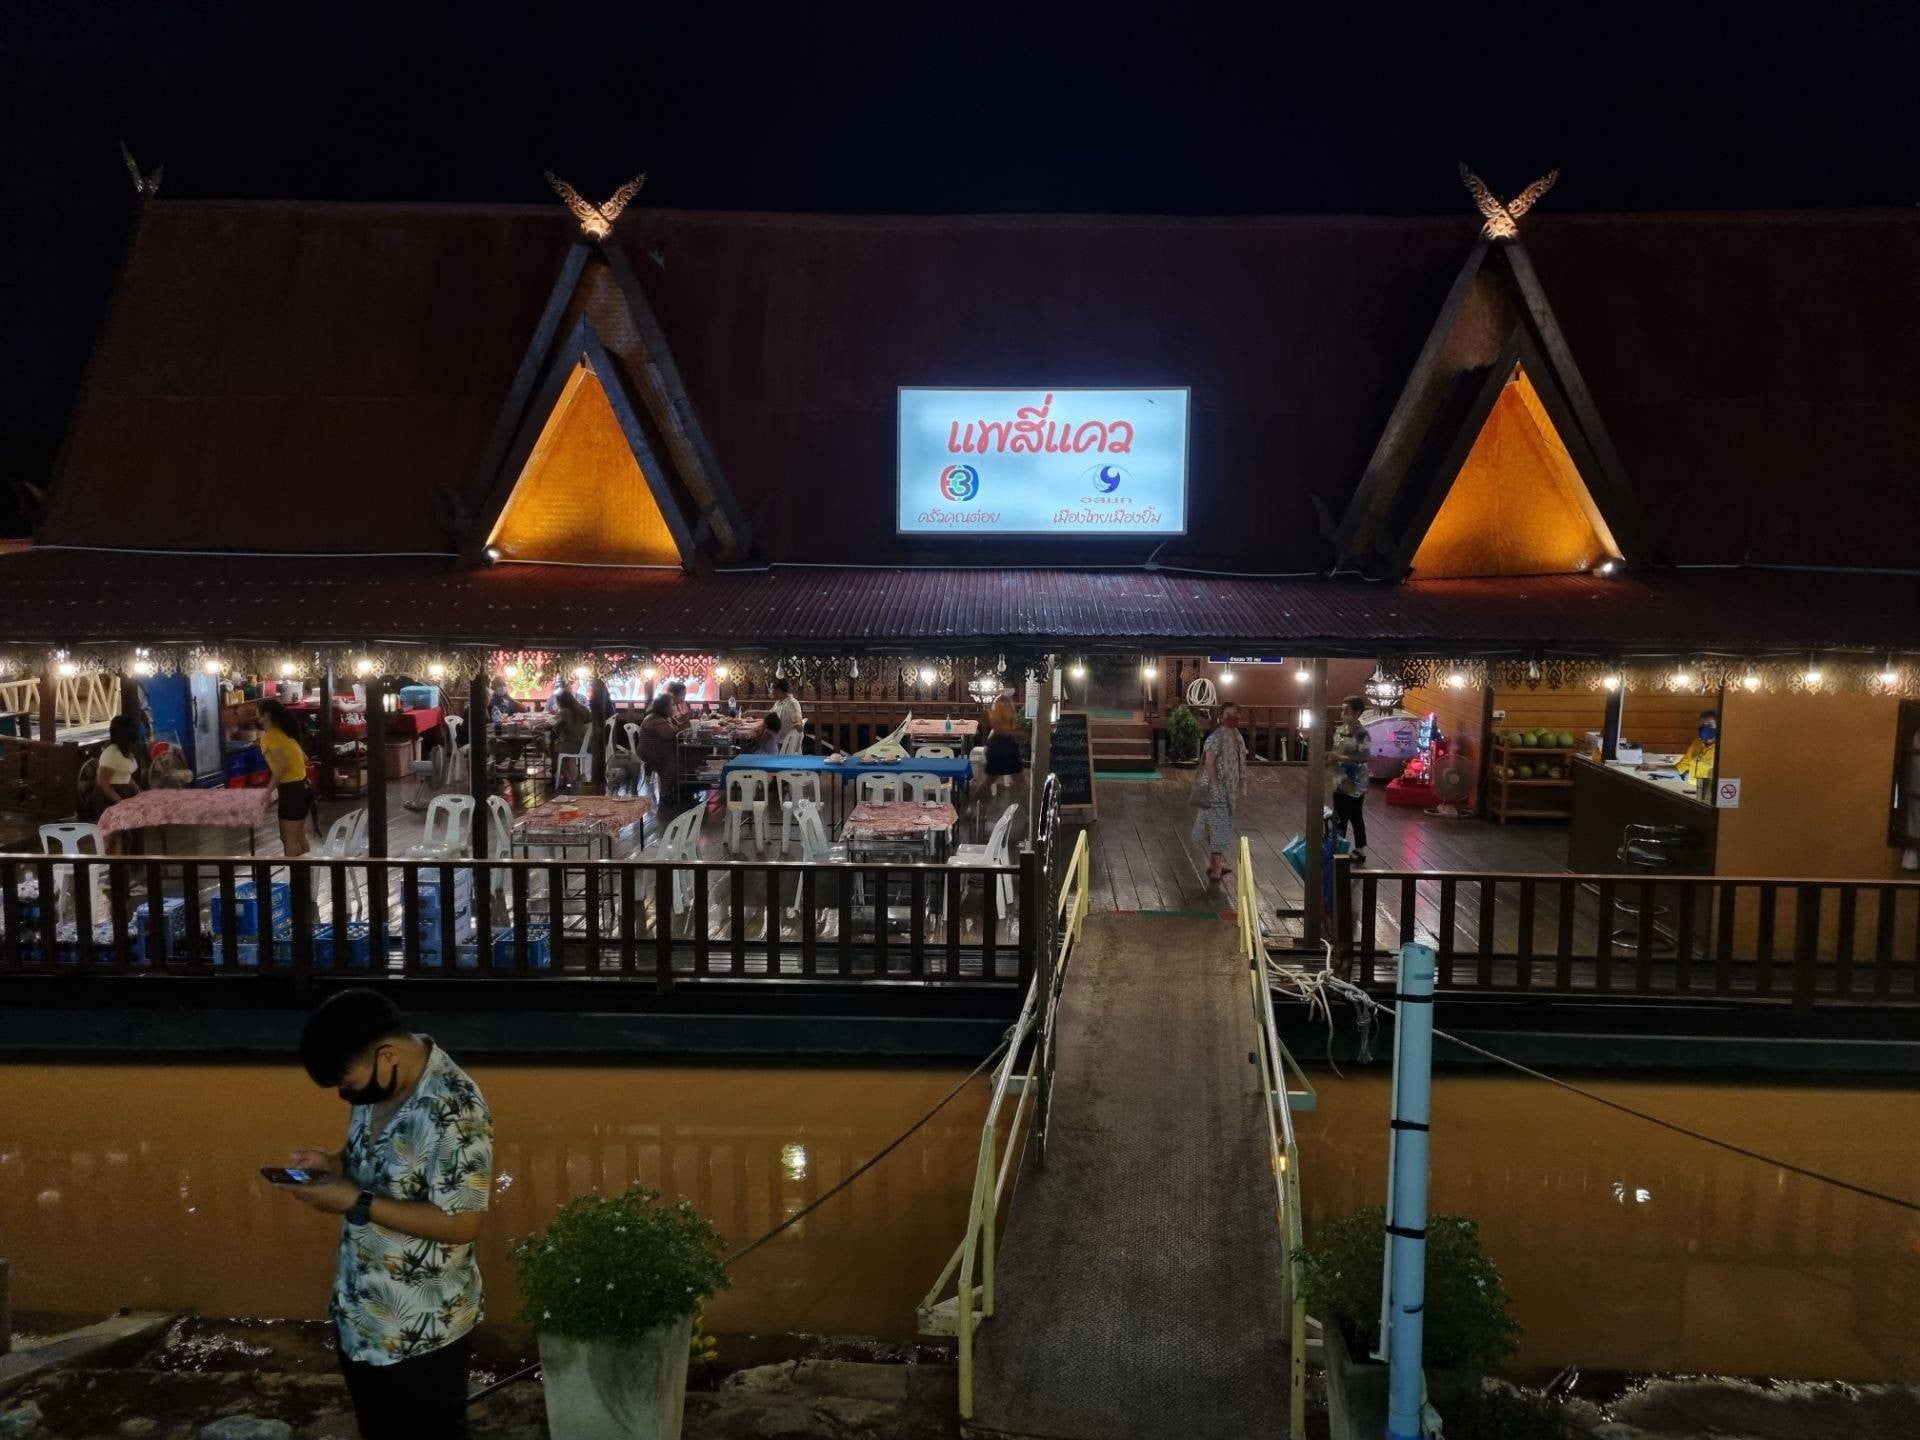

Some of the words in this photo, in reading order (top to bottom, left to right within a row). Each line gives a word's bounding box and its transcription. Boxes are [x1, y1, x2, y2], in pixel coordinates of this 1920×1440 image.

[947, 393, 1134, 455] แพสี่แคว
[917, 508, 1001, 527] ครัวคุณต่อย
[1053, 506, 1162, 525] เมืองไทยเมืองยิ้ม
